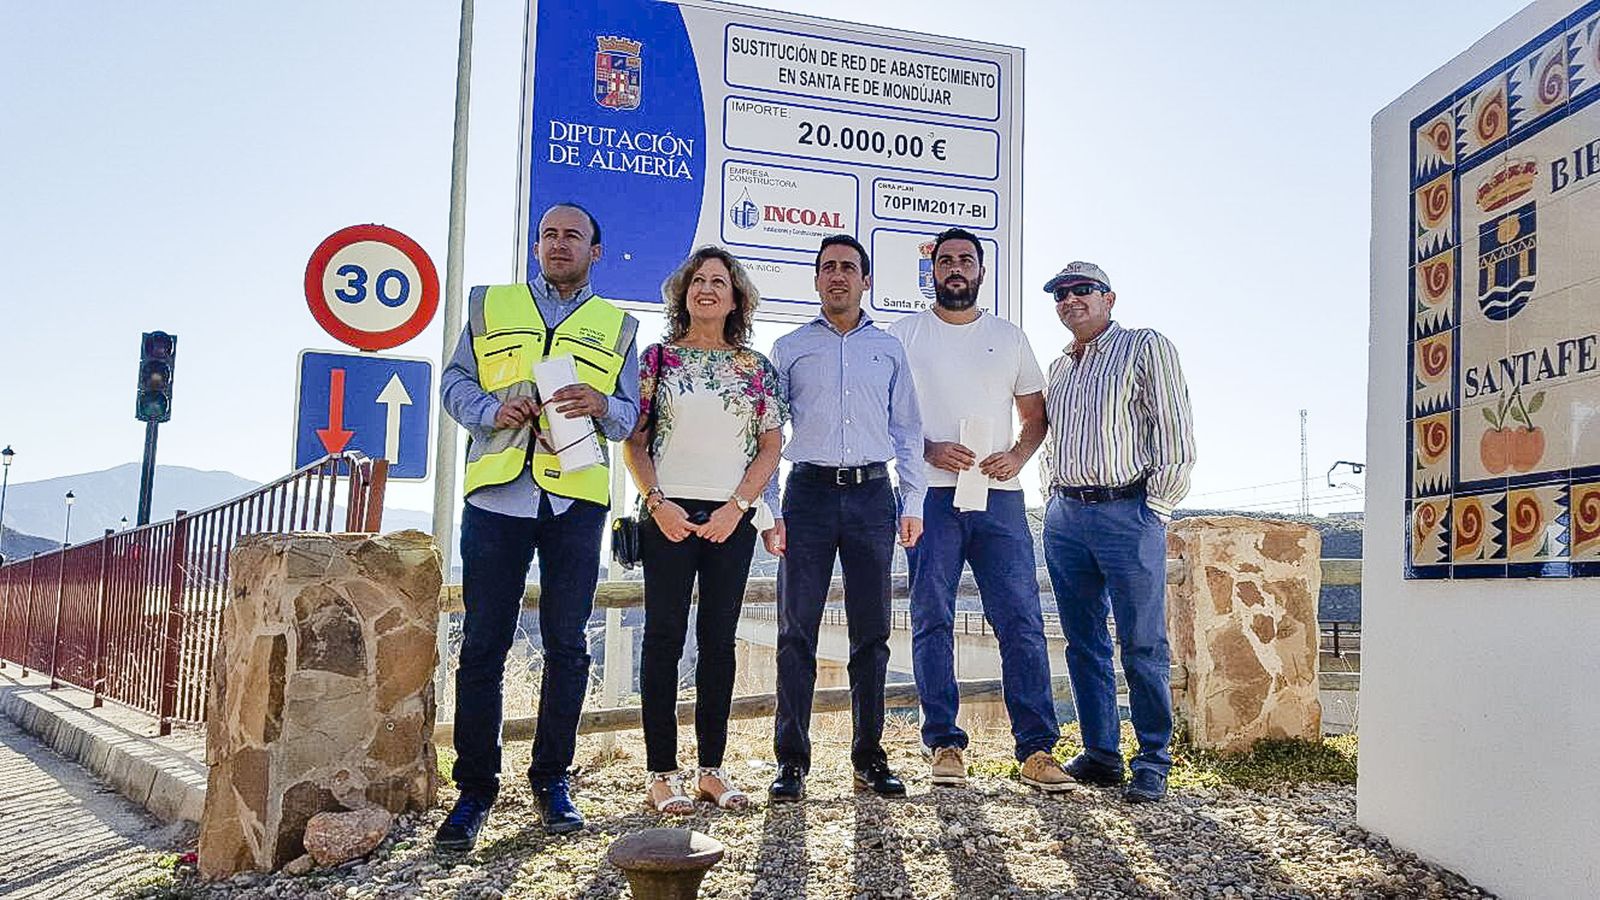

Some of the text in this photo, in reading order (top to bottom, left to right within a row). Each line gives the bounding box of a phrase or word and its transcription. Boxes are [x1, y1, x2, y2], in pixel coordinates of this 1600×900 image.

[732, 37, 995, 89] SUSTITUCIÓN DE RED DE ABASTECIMIENTO
[778, 67, 951, 105] EN SANTA FE DE MONDÚJAR
[549, 120, 694, 158] DIPUTACIÓN
[798, 121, 947, 161] 20.000,00 €
[549, 143, 693, 180] DE ALMERÍA
[729, 167, 770, 178] EMPRESA
[728, 174, 798, 188] CONSTRUCTORA
[764, 205, 845, 229] INCOAL
[883, 195, 987, 219] 70PIM2017-BI
[334, 263, 410, 308] 30
[883, 297, 912, 309] Santa
[914, 300, 926, 309] Fé
